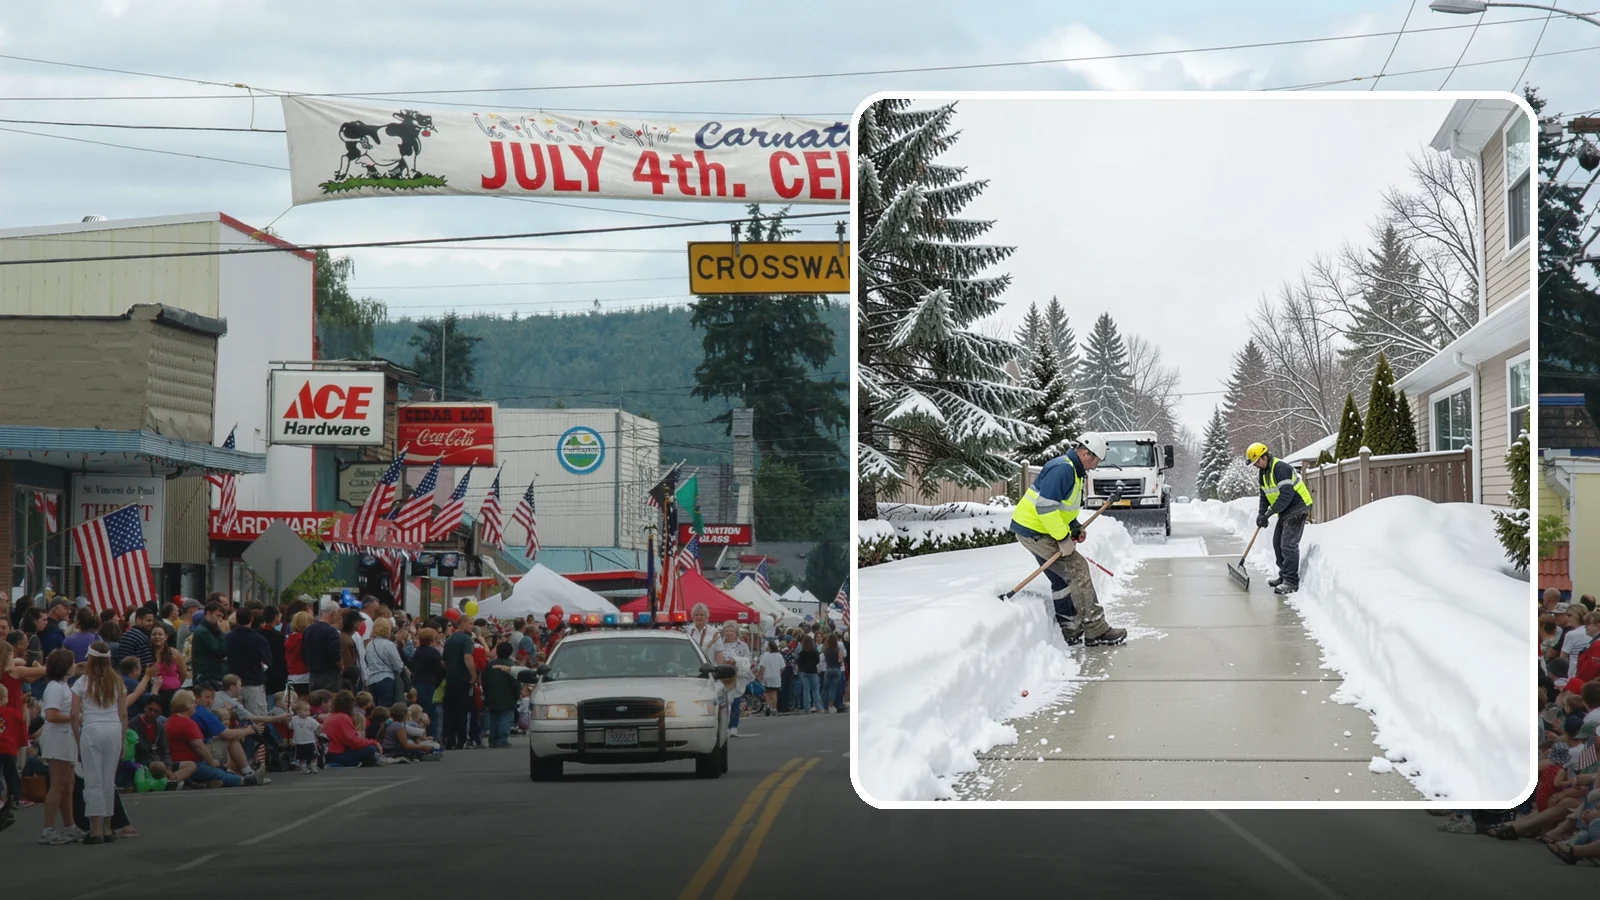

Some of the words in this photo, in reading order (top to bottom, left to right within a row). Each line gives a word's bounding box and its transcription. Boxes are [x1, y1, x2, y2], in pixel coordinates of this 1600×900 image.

[481, 141, 605, 192] JULY
[632, 150, 746, 197] 4th.
[697, 254, 850, 280] CROSSWA
[283, 380, 373, 420] ACE
[406, 409, 452, 421] CEDAR
[283, 421, 370, 436] Hardware
[416, 428, 476, 447] Coca-Cola
[96, 485, 124, 494] Vincent
[126, 486, 135, 494] de
[138, 486, 155, 495] Paul
[699, 535, 730, 543] GLASS
